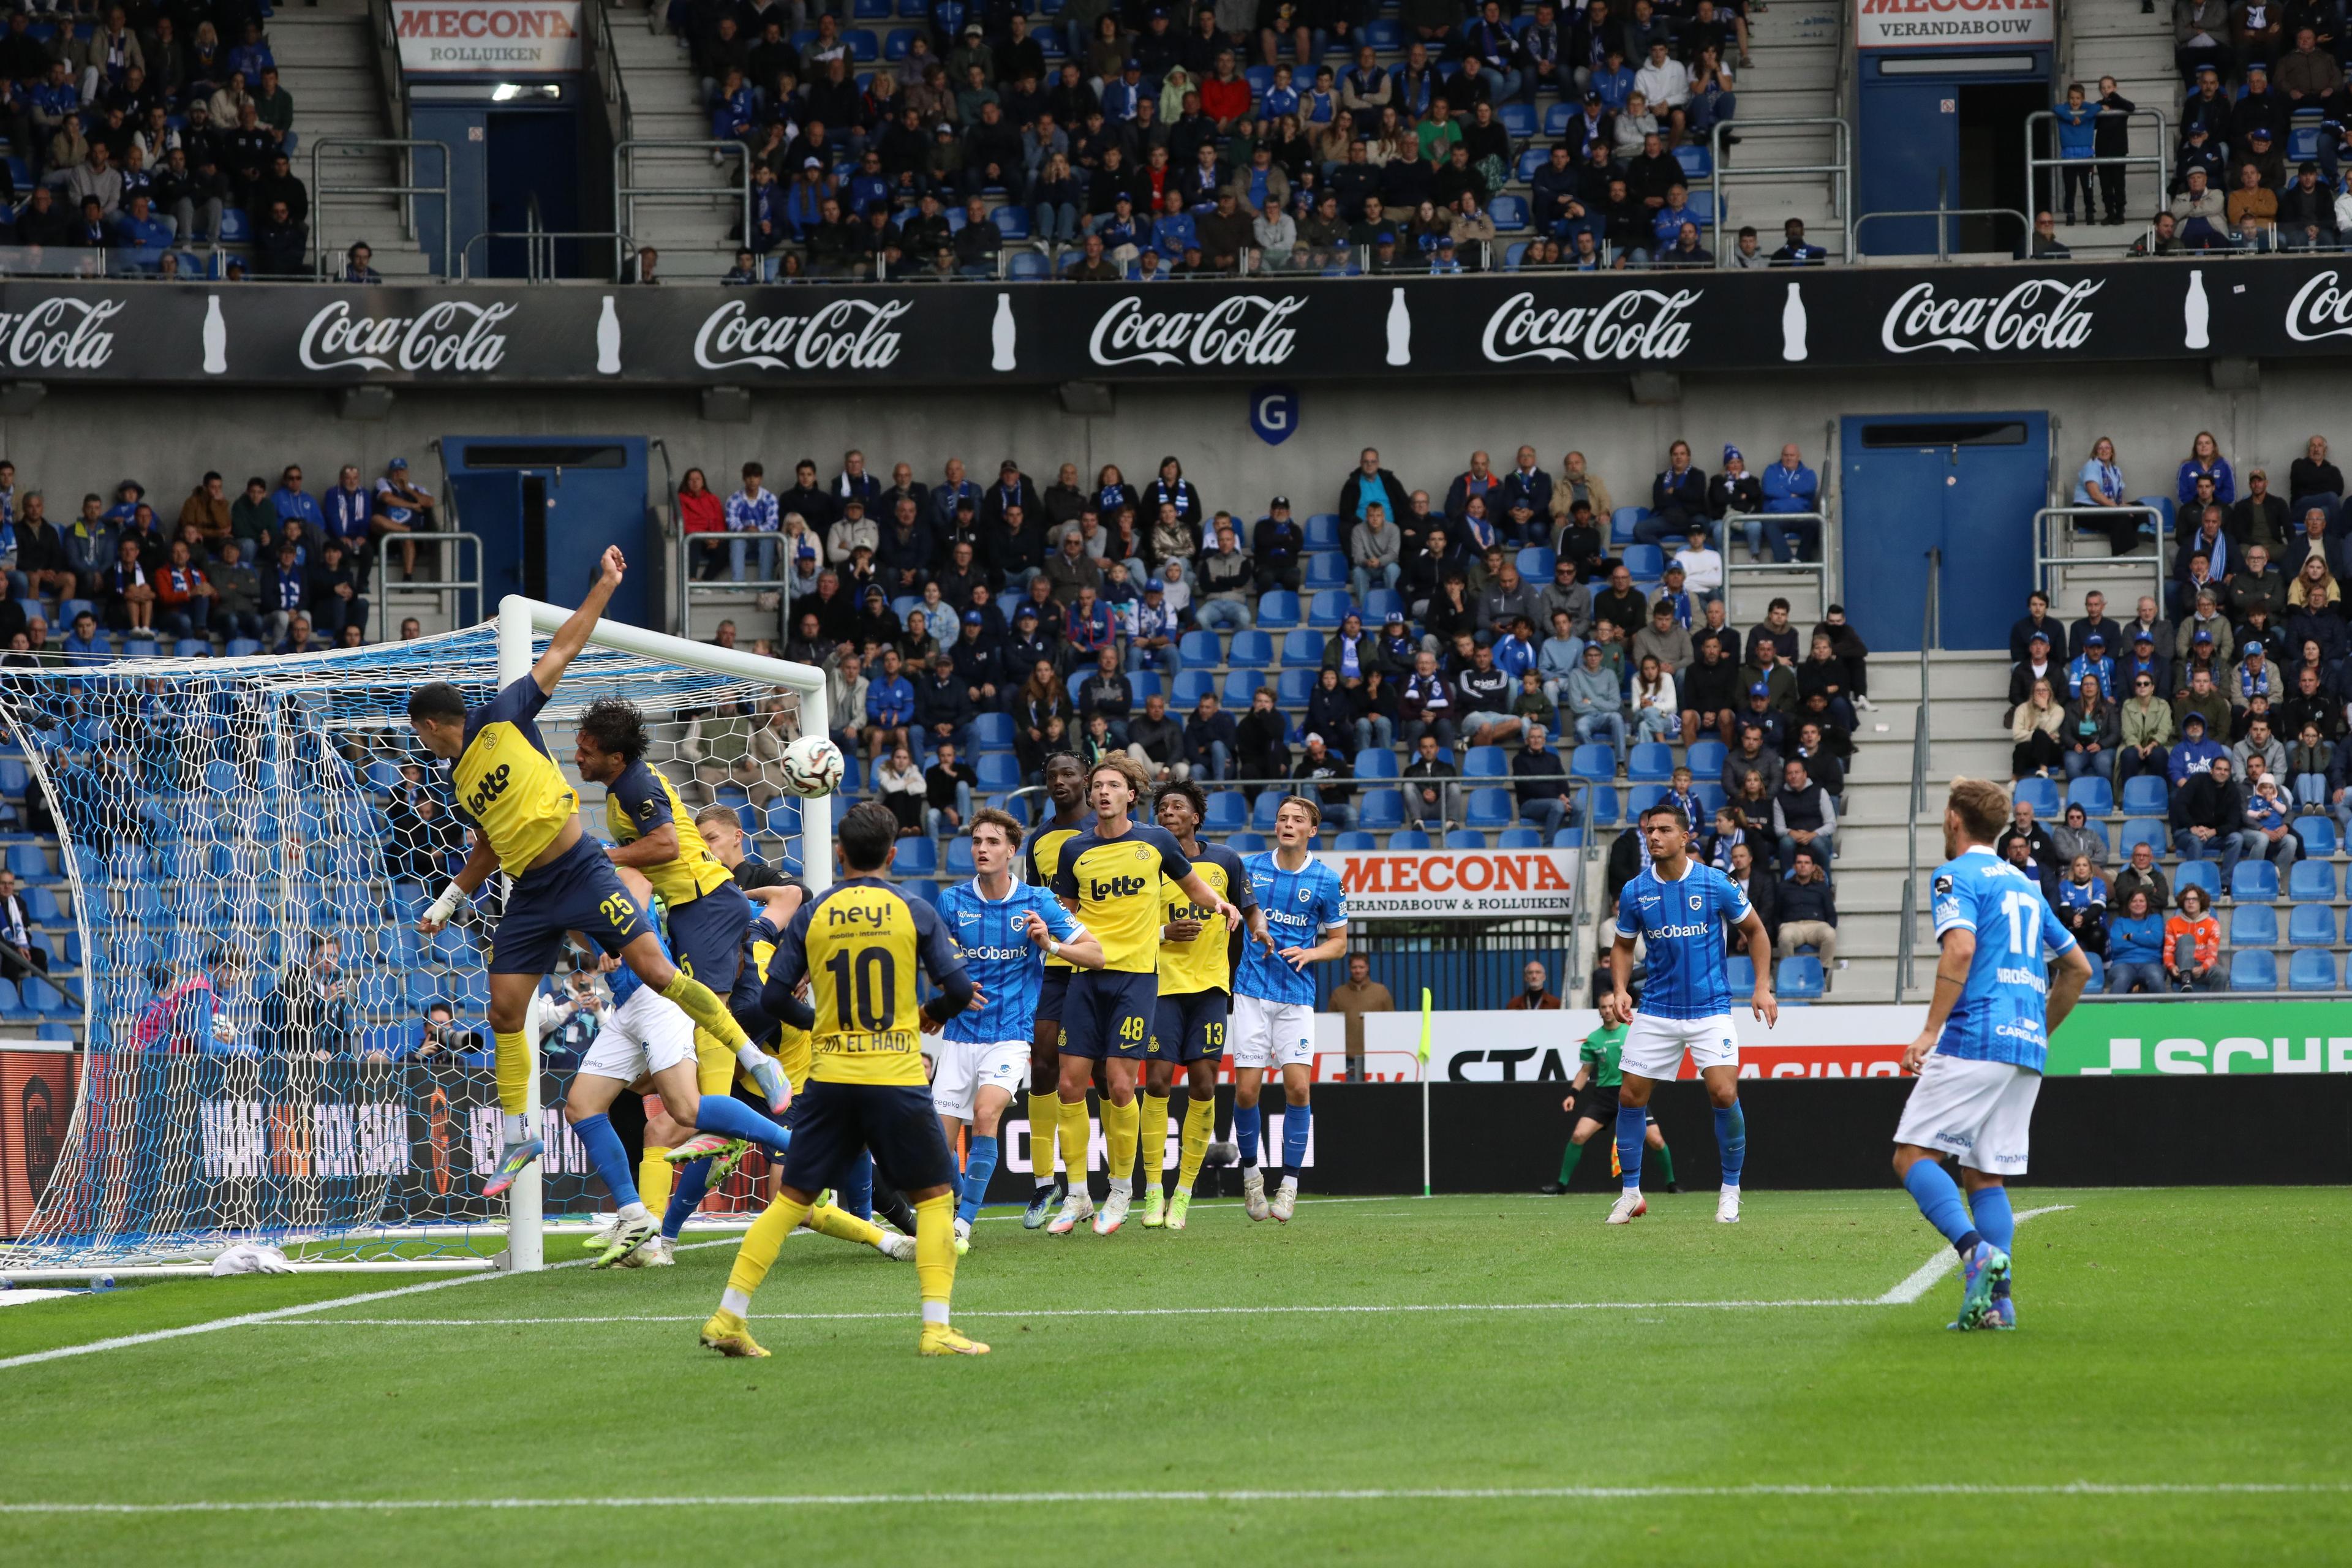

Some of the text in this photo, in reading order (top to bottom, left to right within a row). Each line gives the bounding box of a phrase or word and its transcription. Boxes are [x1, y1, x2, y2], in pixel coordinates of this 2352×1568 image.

[397, 10, 578, 38] MECONA
[1879, 19, 2032, 36] VERANDABOUW
[430, 47, 542, 61] ROLLUIKEN
[1482, 288, 1704, 363] Coca-Cola
[1882, 277, 2106, 354] Coca-Cola
[299, 300, 519, 372] Coca-Cola
[694, 299, 913, 370] Coca-Cola
[1089, 295, 1309, 366] Coca-Cola
[1259, 394, 1286, 430] G
[1344, 855, 1570, 893] MECONA
[600, 892, 635, 927] 25
[829, 903, 891, 928] hey!
[1168, 901, 1216, 923] Lott
[1347, 897, 1570, 911] ERANDABOUW & ROLLUIKEN
[1263, 908, 1308, 927] Obank
[2001, 890, 2040, 959] 17
[825, 946, 895, 1031] 10
[1120, 1016, 1144, 1041] 48
[1204, 1022, 1224, 1045] 13
[847, 1035, 866, 1053] EL
[1625, 1058, 1648, 1069] cegeka
[933, 1099, 960, 1109] cegeka
